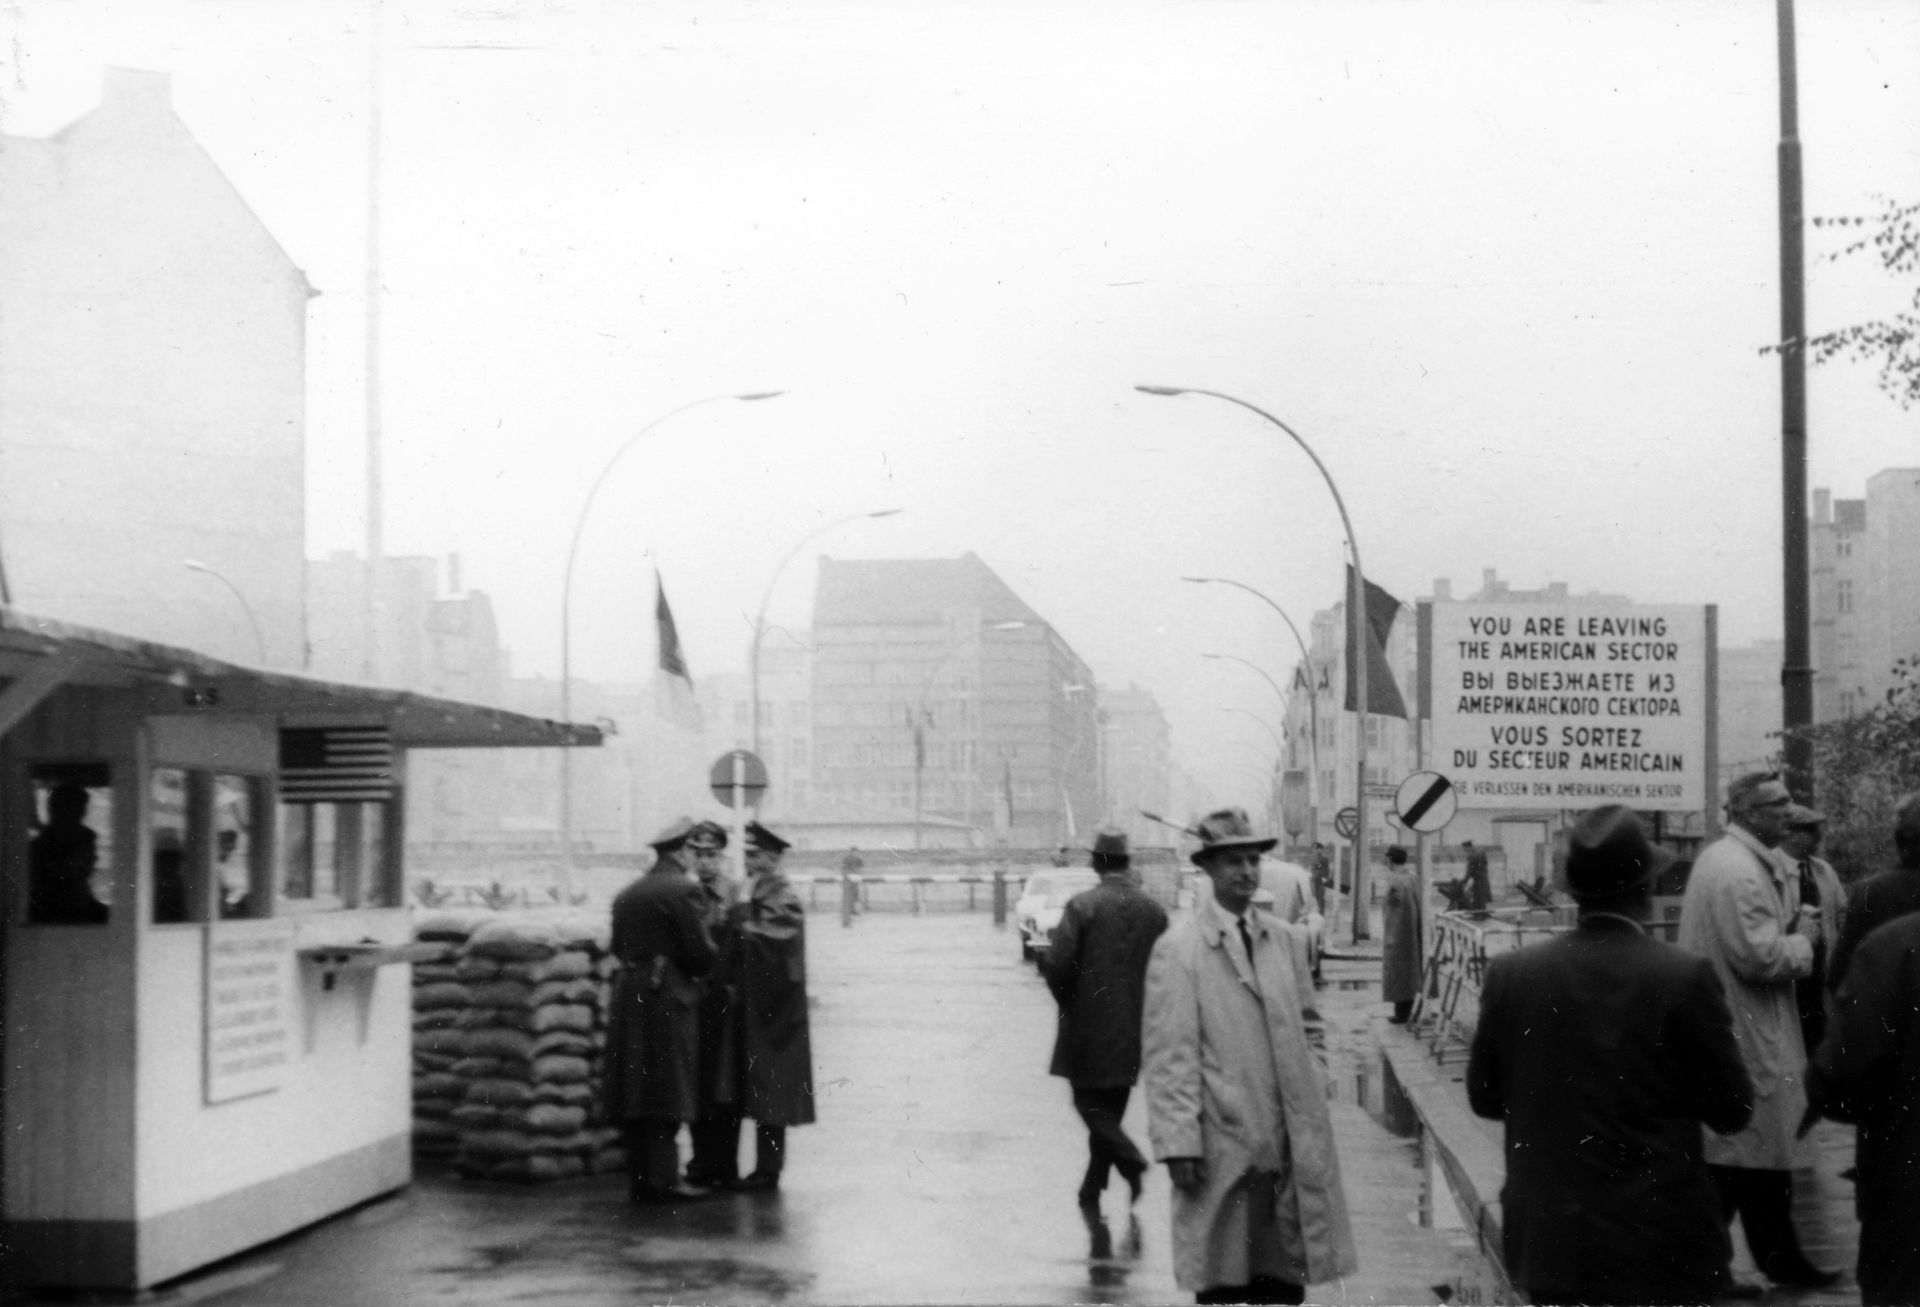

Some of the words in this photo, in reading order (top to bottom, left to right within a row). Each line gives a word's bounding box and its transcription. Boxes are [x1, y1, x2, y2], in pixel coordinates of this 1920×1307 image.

[1469, 617, 1511, 636] YOU
[1524, 617, 1565, 636] ARE
[1578, 617, 1667, 637] LEAVING
[1459, 641, 1490, 660] THE
[1500, 641, 1596, 661] AMERICAN
[1607, 642, 1678, 661] SECTOR
[1463, 671, 1494, 690] ВЫ
[1507, 671, 1634, 692] ВЫЕЗЖАЕТЕ
[1649, 673, 1675, 693] ИЗ
[1457, 696, 1599, 716] АМЕРИКАНСКОГО
[1607, 697, 1681, 716] СЕКТОРА
[1491, 726, 1548, 746] VOUS
[1562, 726, 1642, 748] SORTEZ
[1454, 750, 1477, 769] DU
[1489, 750, 1570, 770] SECTEUR
[1580, 752, 1683, 772] AMERICAIN
[1473, 782, 1528, 796] VERLASSEN
[1533, 782, 1552, 796] DEN
